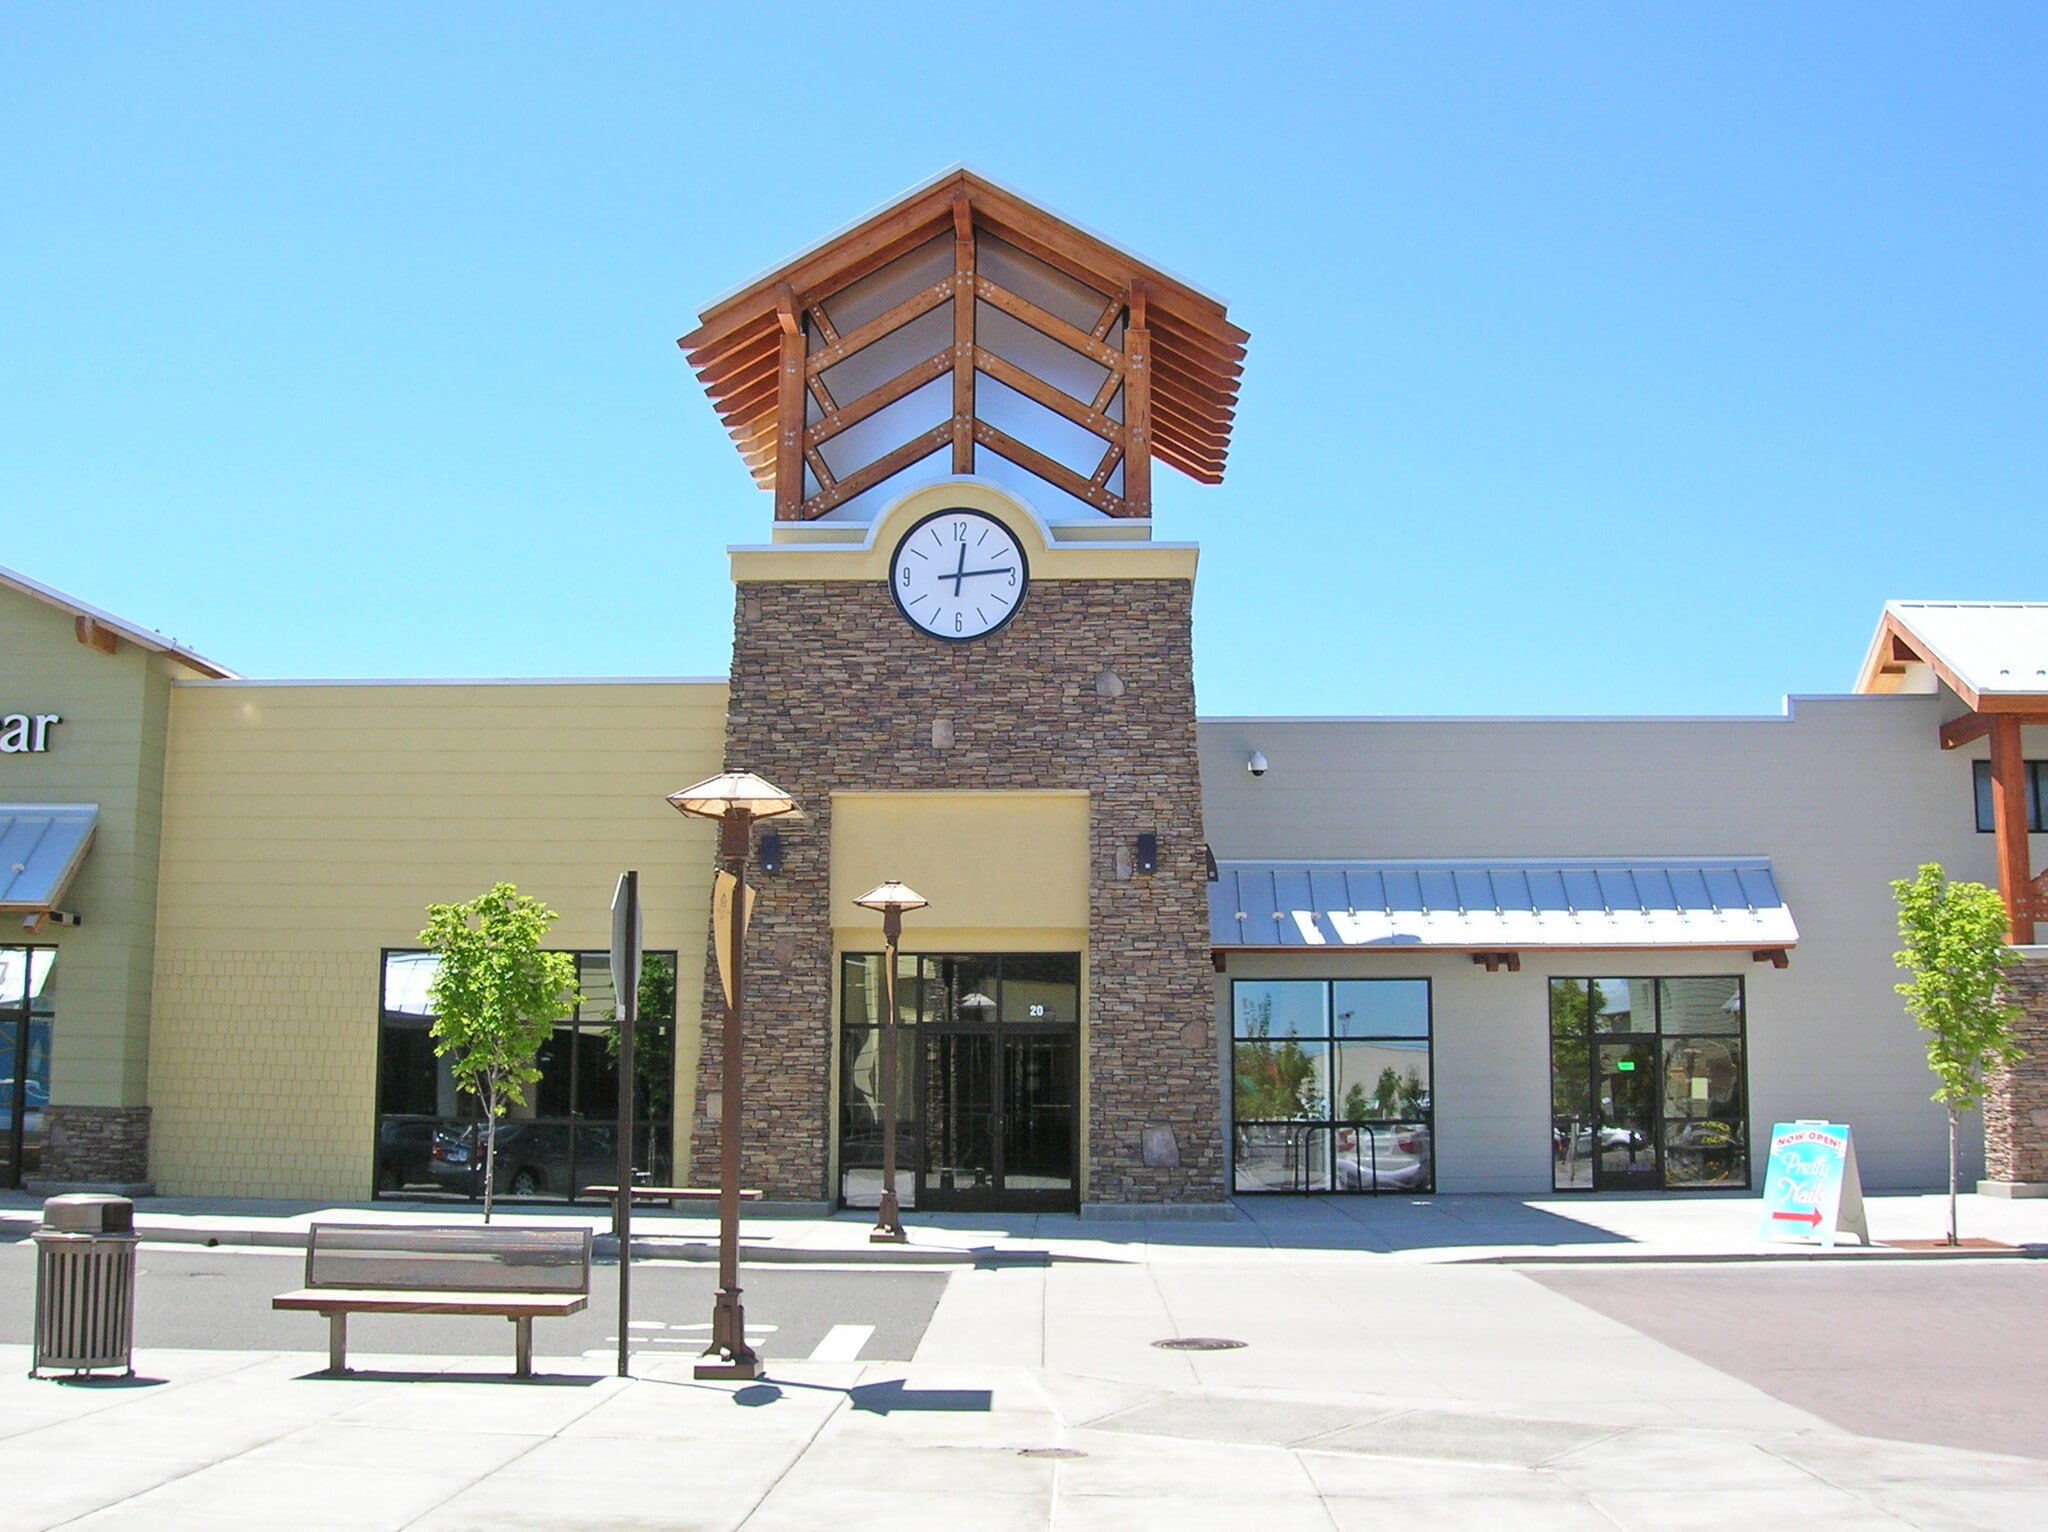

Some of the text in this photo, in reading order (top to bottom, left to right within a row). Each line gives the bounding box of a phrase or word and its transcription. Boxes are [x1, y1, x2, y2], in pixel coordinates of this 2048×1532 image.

[953, 521, 968, 542] 12
[903, 566, 911, 588] 9
[1008, 566, 1017, 587] 3
[954, 611, 963, 633] 6
[1029, 1004, 1044, 1017] 20
[1777, 1131, 1842, 1148] NOW OPEN!
[1781, 1151, 1831, 1180] Pretty
[1776, 1176, 1825, 1204] Nails
